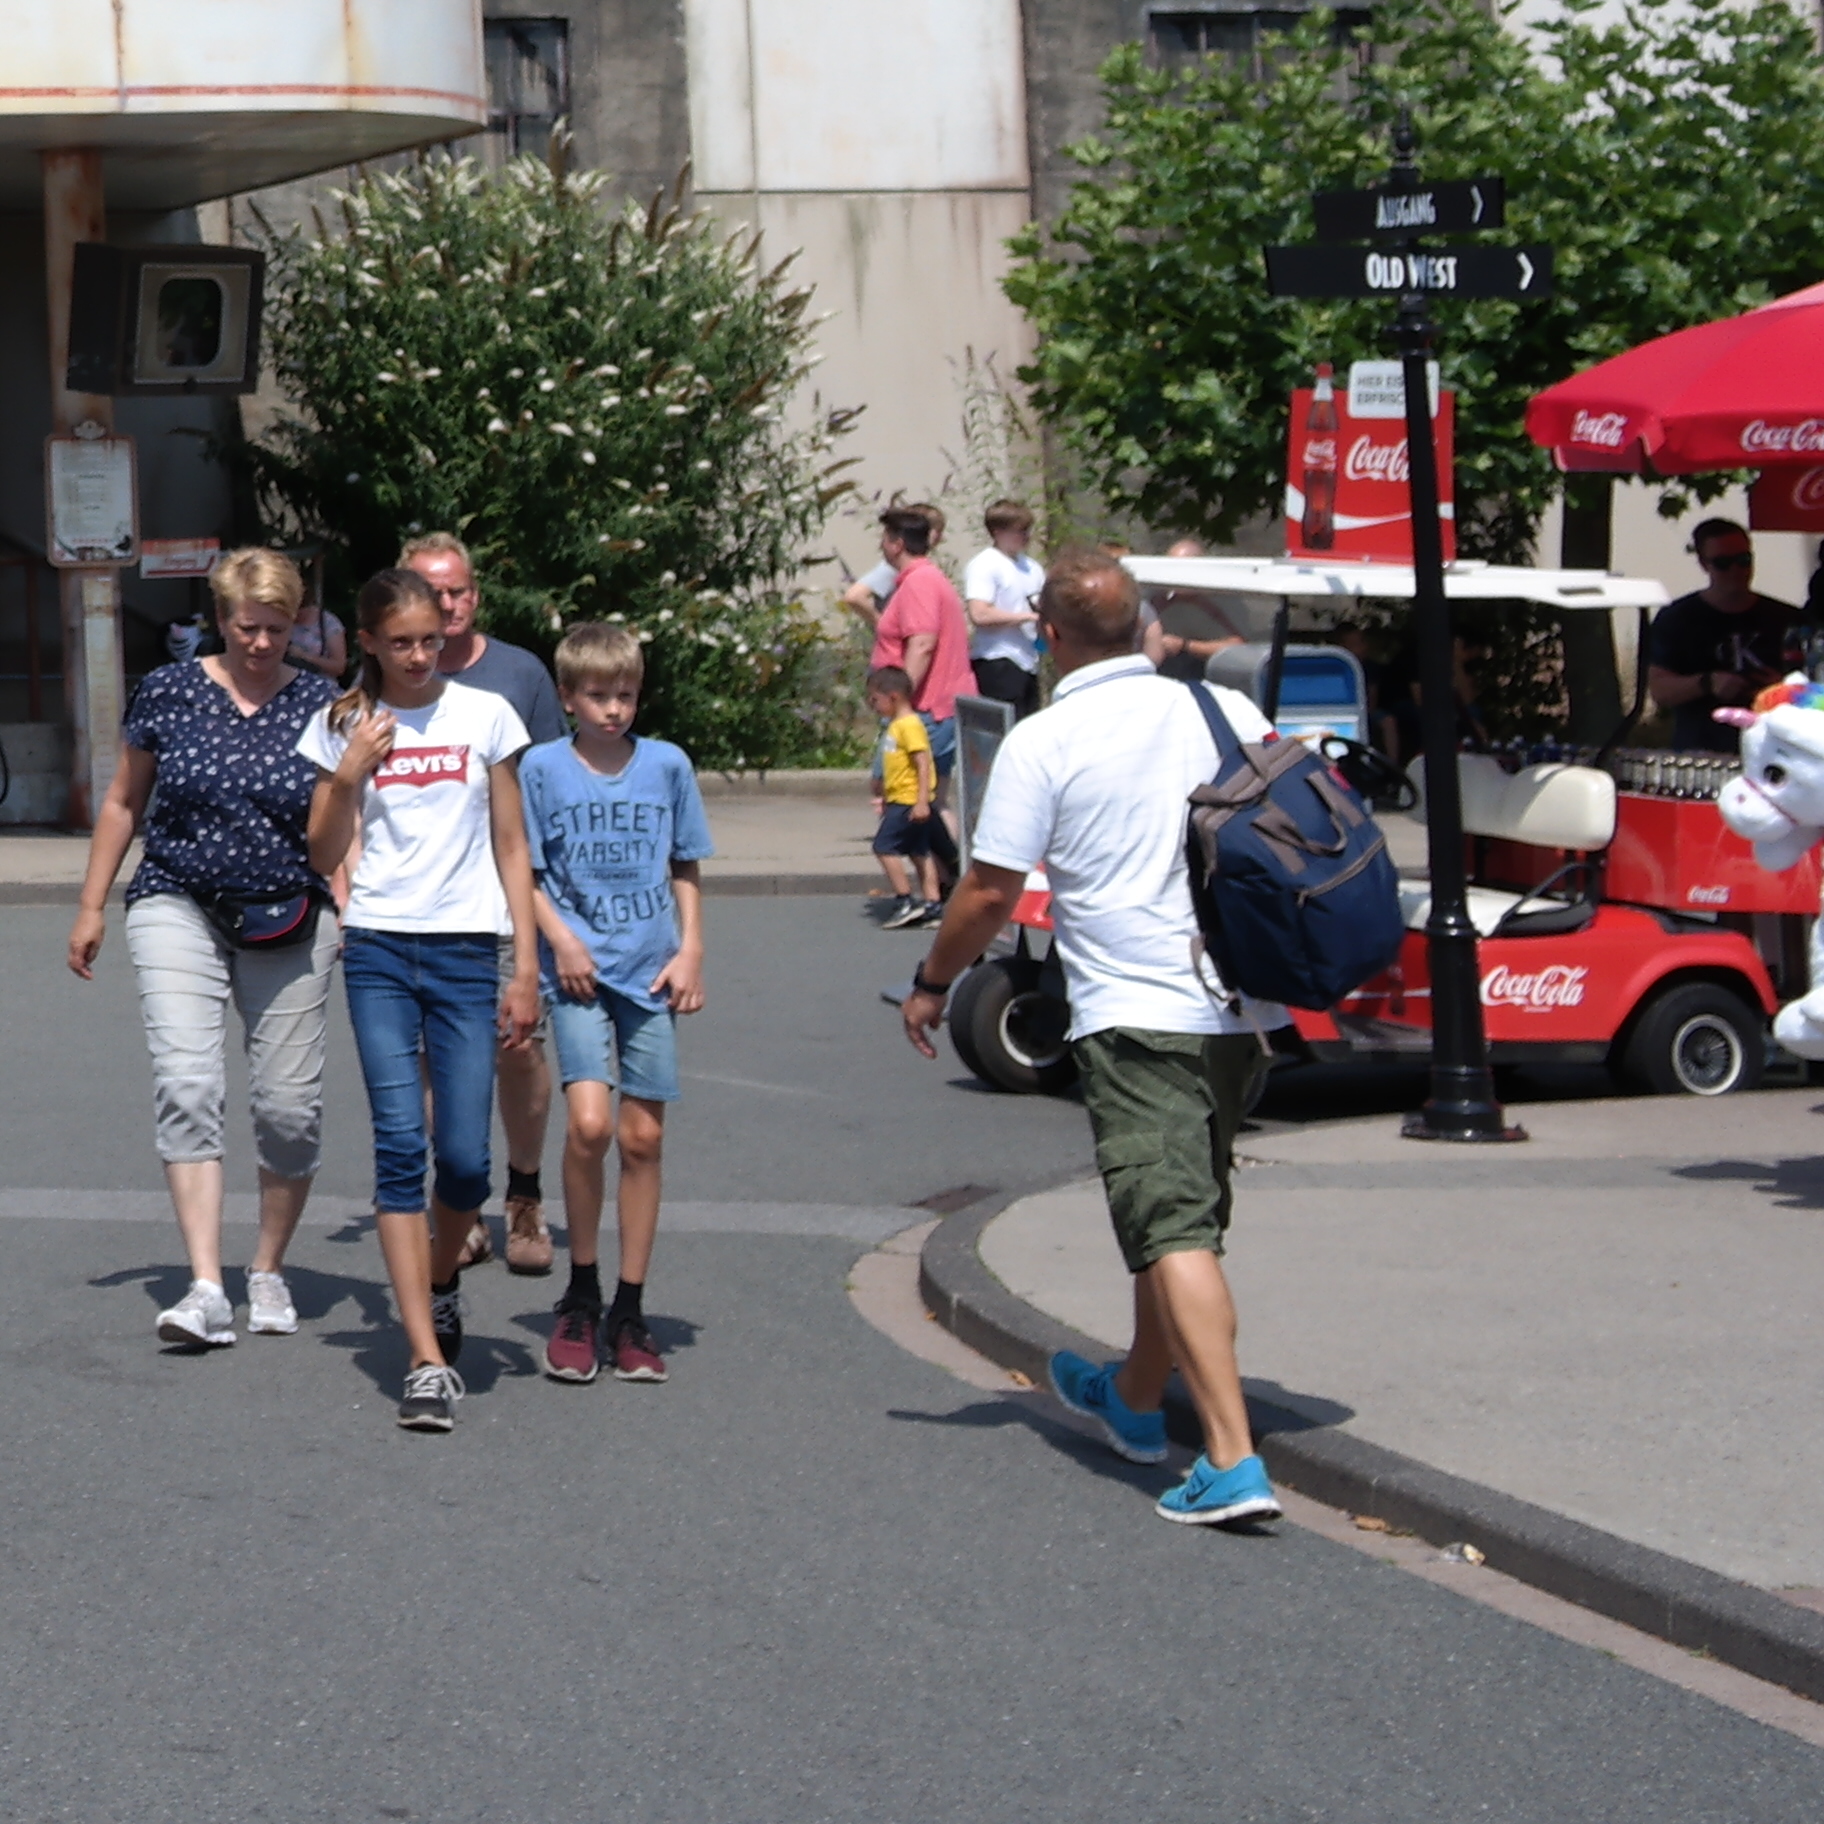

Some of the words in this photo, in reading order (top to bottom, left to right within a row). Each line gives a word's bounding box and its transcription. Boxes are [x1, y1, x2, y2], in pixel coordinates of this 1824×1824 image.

[1375, 192, 1437, 229] AUSGANG
[1365, 251, 1405, 290] OLD
[1406, 253, 1458, 290] WEST
[544, 801, 669, 842] STREET
[560, 839, 659, 864] VARSITY
[1479, 964, 1589, 1006] Coca-Cola
